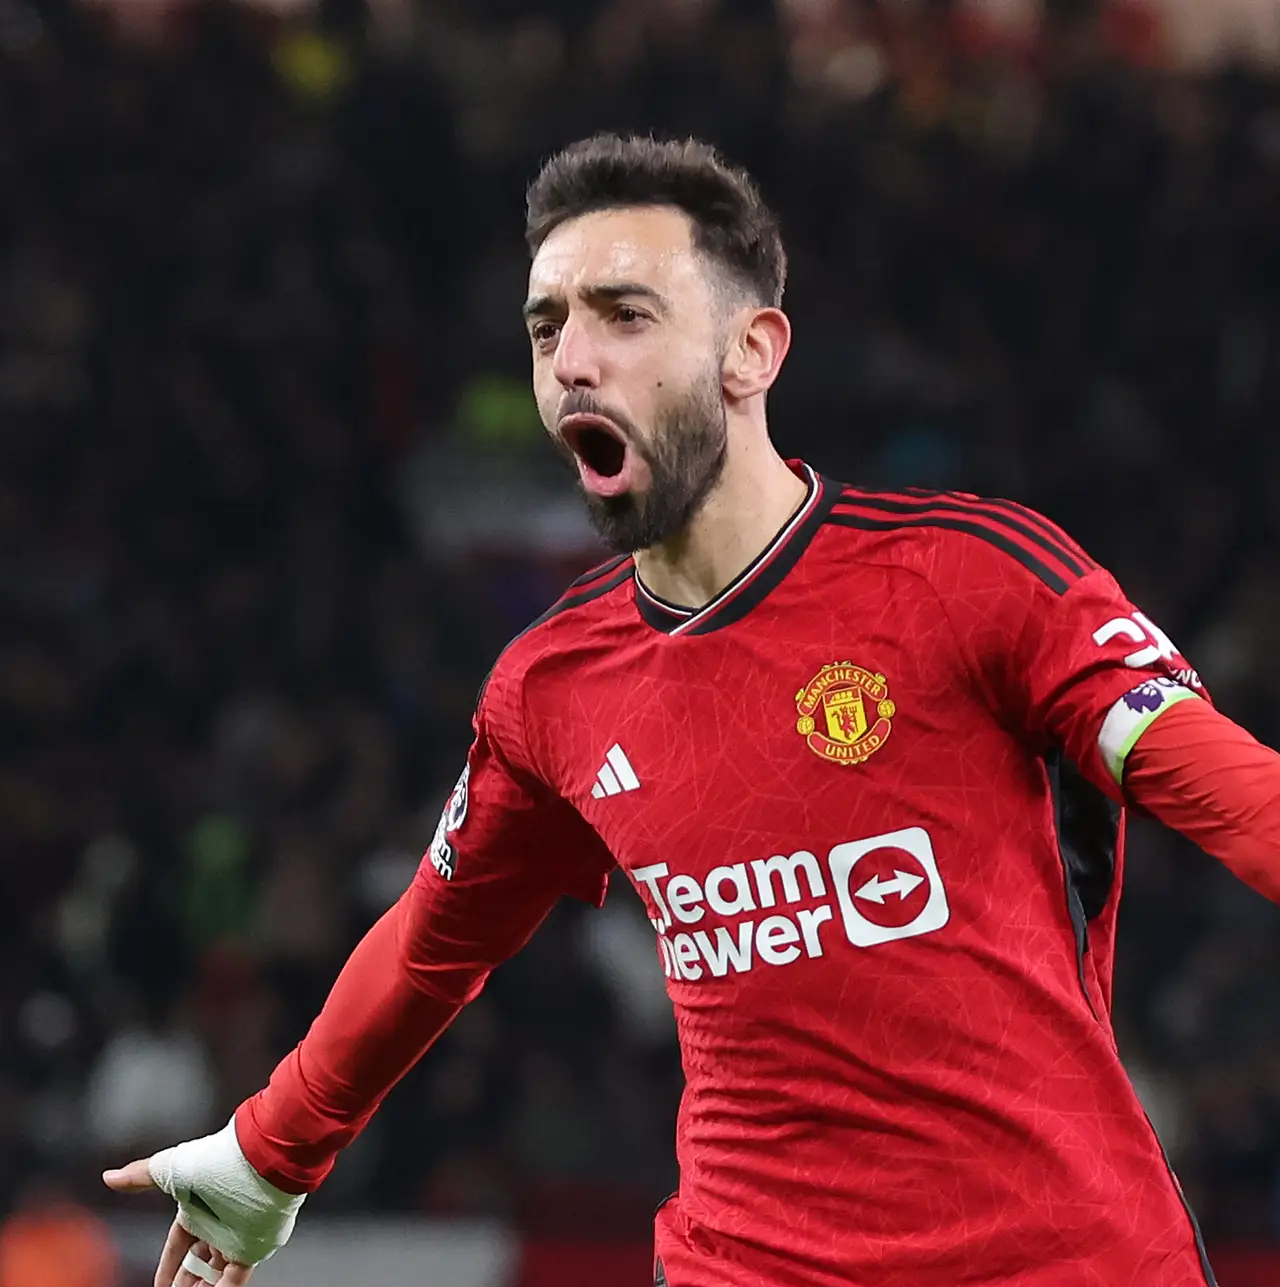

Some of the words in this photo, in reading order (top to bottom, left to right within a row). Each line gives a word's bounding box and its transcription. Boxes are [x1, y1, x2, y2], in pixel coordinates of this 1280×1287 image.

[803, 669, 881, 709] MANCHESTER
[825, 735, 880, 758] UNITED
[631, 850, 826, 928] Team
[651, 904, 833, 981] iewer
